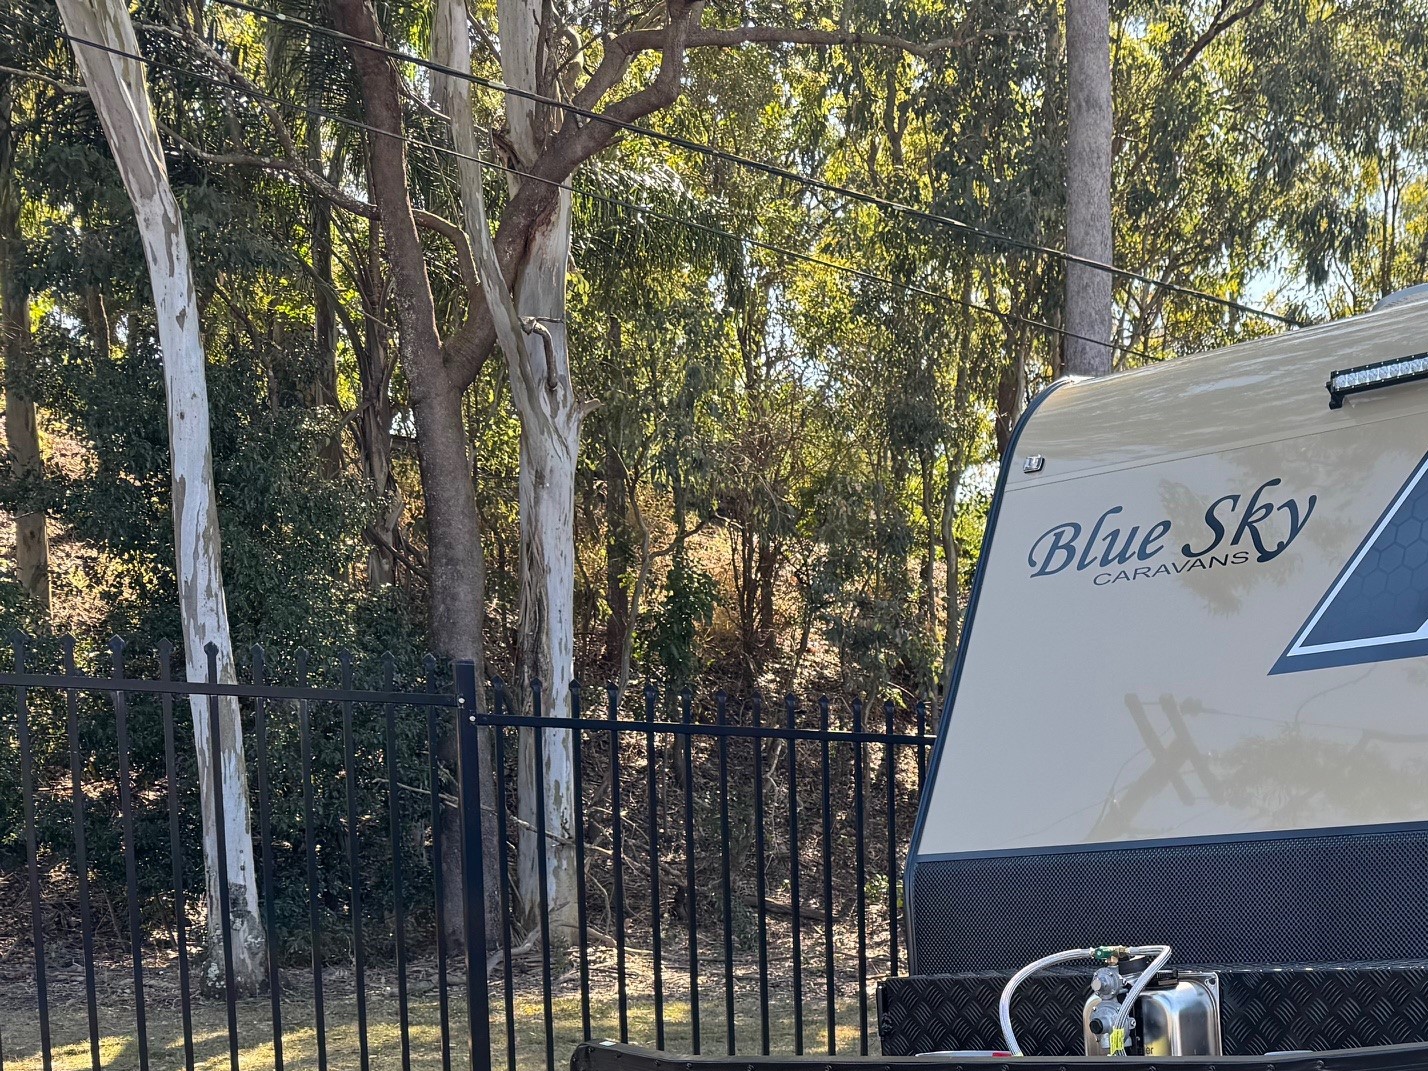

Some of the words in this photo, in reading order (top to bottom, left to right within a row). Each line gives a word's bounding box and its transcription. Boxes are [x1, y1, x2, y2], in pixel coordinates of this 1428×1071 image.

[1028, 505, 1171, 578] Blue
[1181, 477, 1317, 563] Sky
[1092, 550, 1250, 586] CARAVANS
